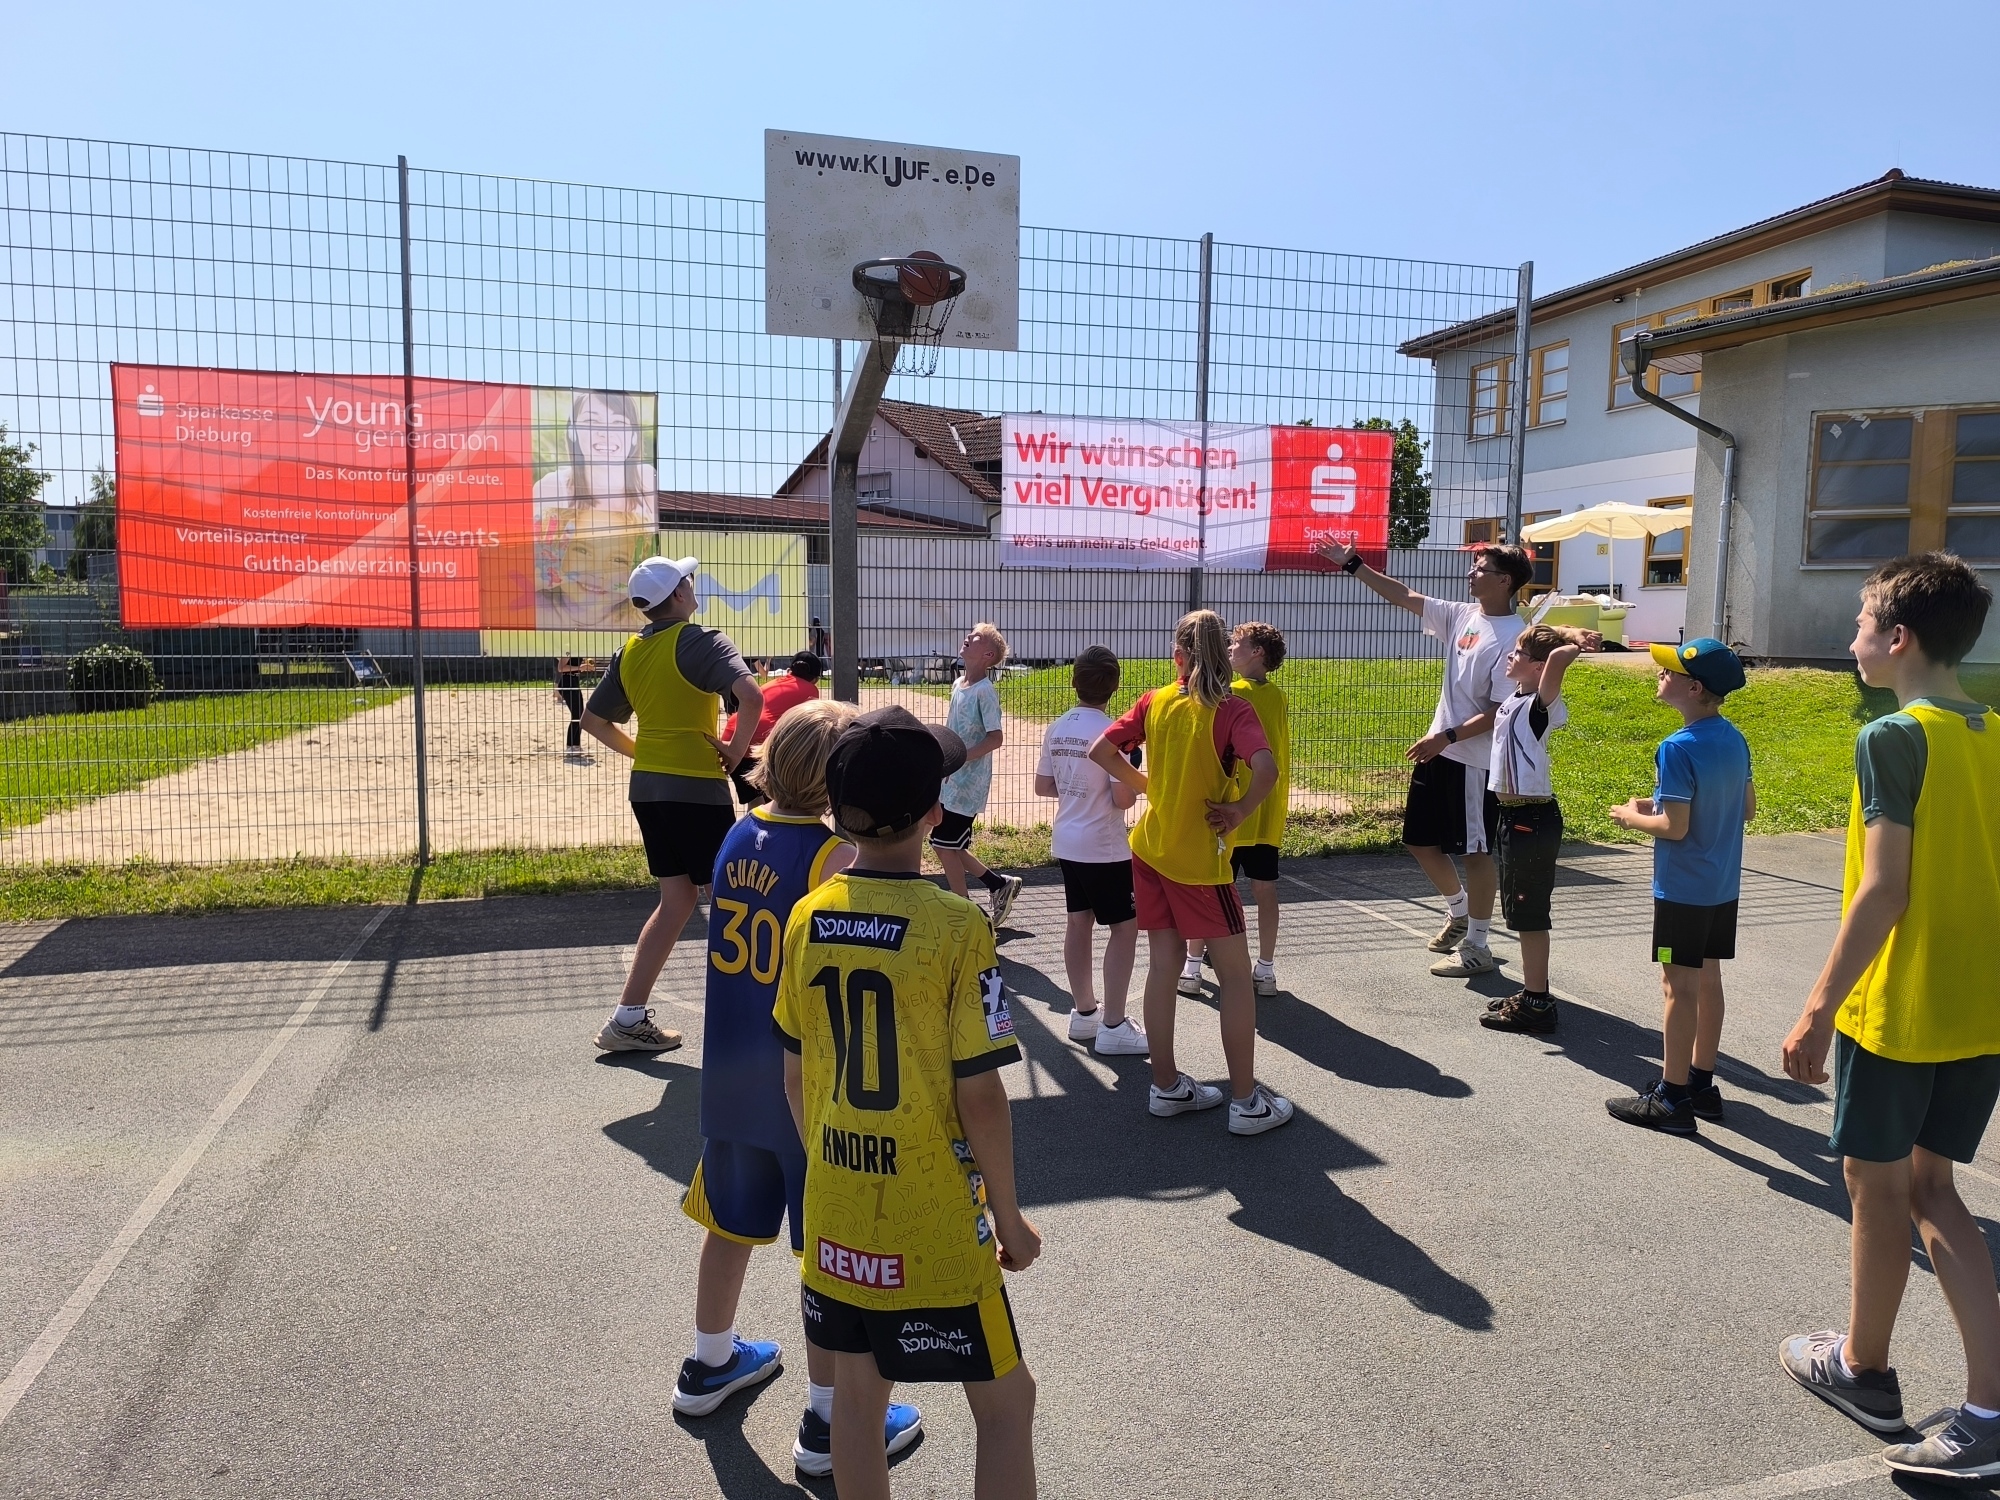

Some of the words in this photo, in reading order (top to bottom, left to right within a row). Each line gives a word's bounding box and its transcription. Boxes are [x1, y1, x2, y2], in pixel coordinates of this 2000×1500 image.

[175, 402, 274, 421] Sparkasse
[303, 396, 422, 437] young
[175, 426, 252, 447] Dieburg
[355, 428, 498, 453] generation
[1014, 432, 1072, 464] Wir
[1080, 437, 1237, 470] wünschen
[305, 467, 334, 481] Das
[338, 468, 382, 482] Konto
[386, 469, 408, 483] für
[410, 469, 455, 487] junge
[459, 471, 504, 486] Leute.
[1014, 473, 1072, 505] viel
[1081, 476, 1257, 517] Vergnügen!
[243, 507, 312, 520] Kostenfreie
[315, 508, 397, 523] Kontoführung
[175, 527, 308, 547] Vorteilspartner
[412, 524, 500, 548] Events
[1013, 534, 1053, 549] Weil's
[1055, 538, 1077, 550] um
[1080, 536, 1115, 550] mehr
[1117, 536, 1136, 551] als
[1140, 537, 1172, 552] Geld
[1304, 526, 1359, 541] Sparkasse
[243, 554, 457, 578] Guthabenverzinsung
[726, 858, 779, 897] CURRY
[710, 896, 781, 985] 30
[808, 965, 900, 1112] 10
[821, 1122, 898, 1176] KNORR
[820, 1241, 901, 1286] REWE
